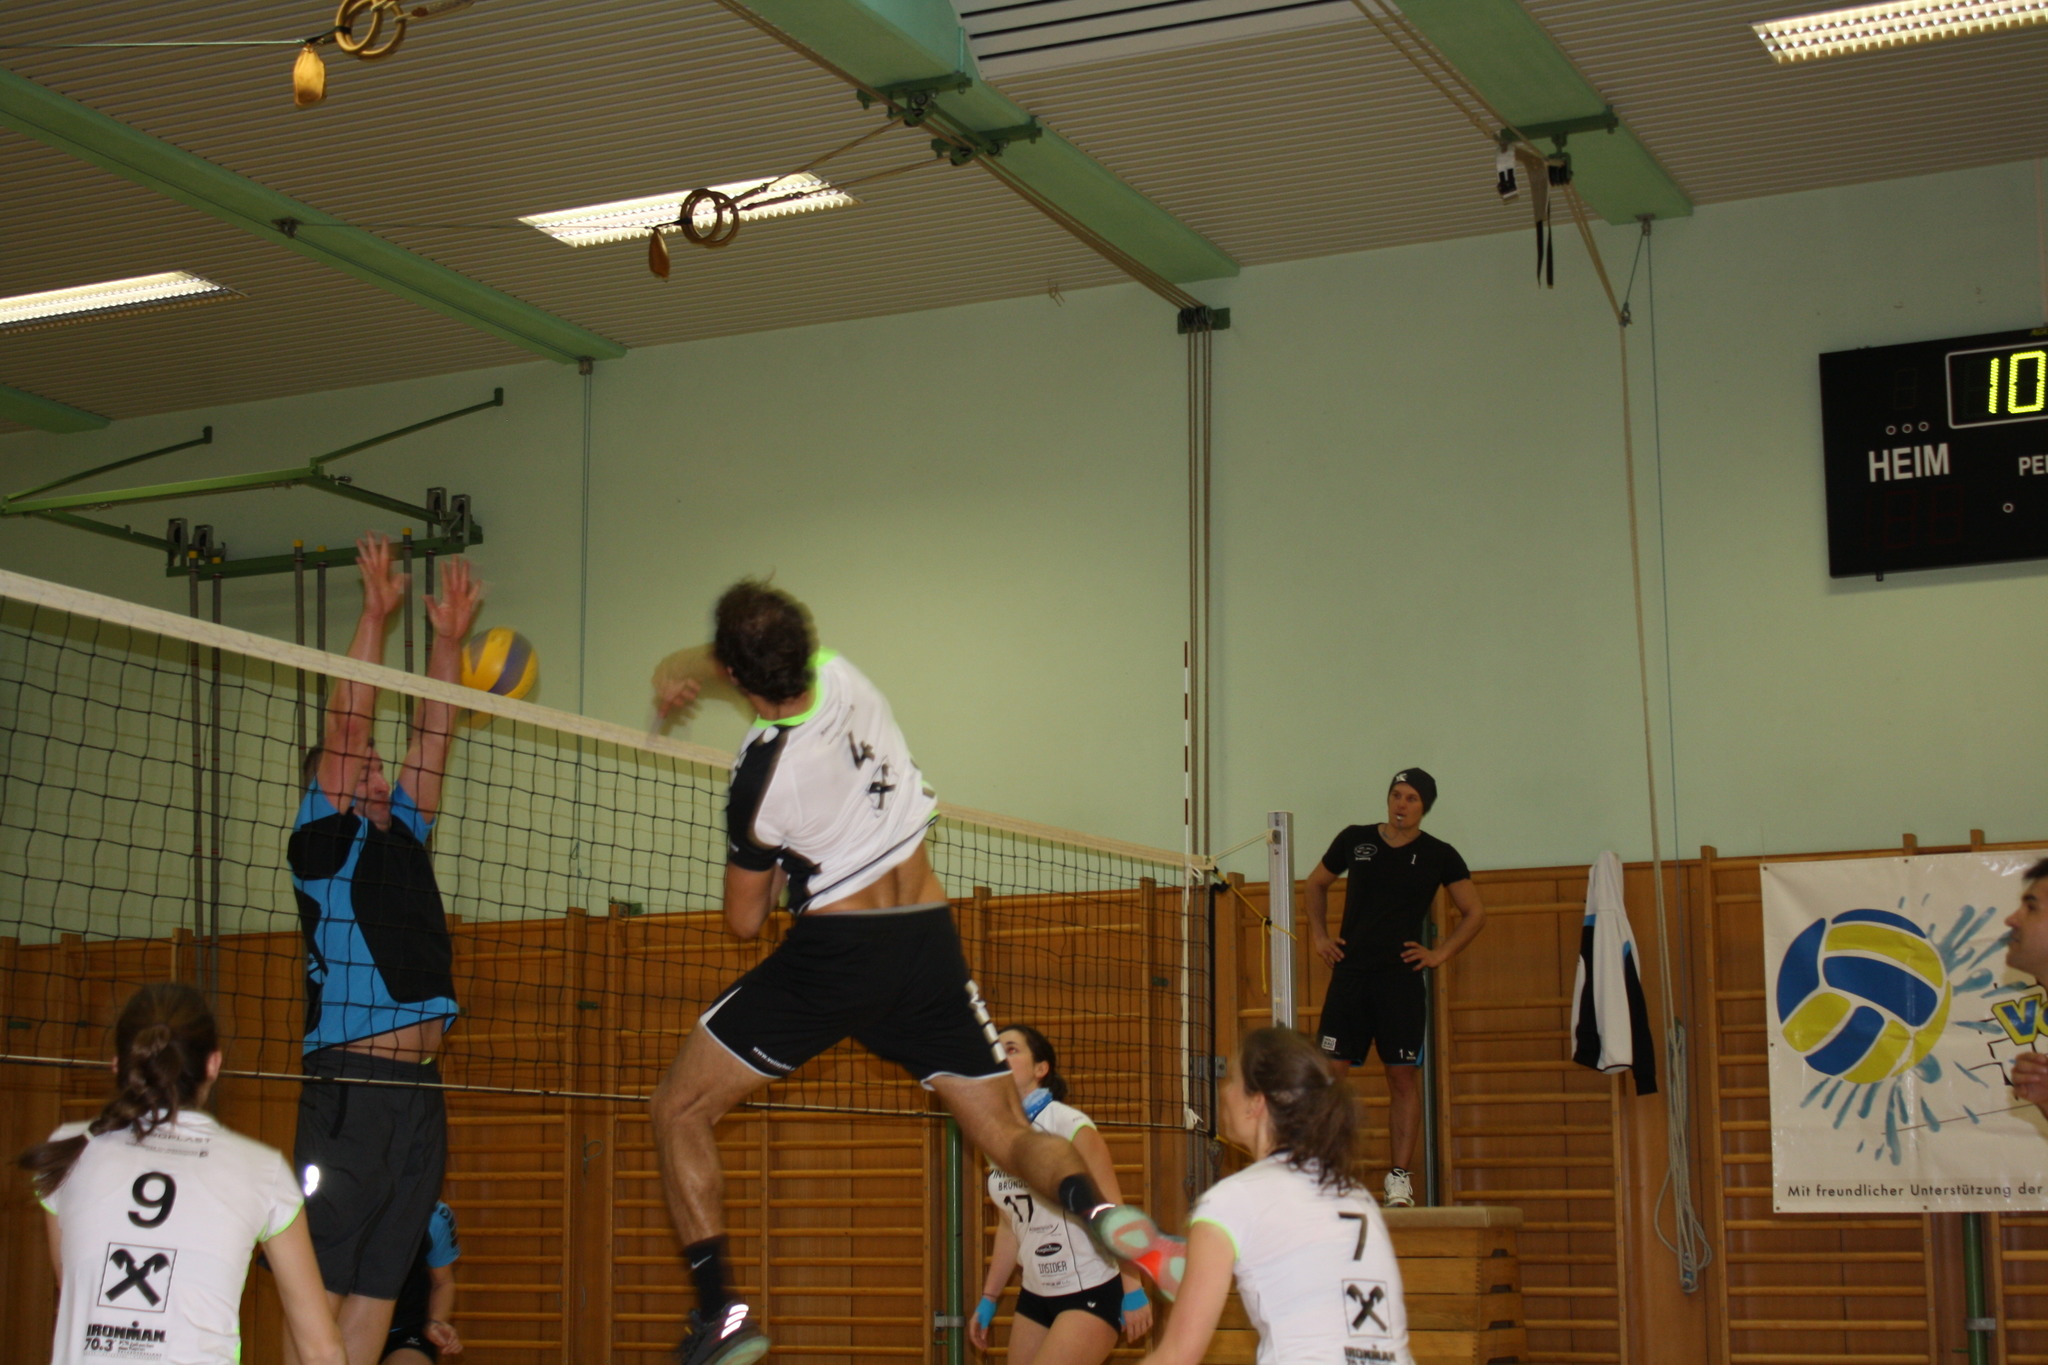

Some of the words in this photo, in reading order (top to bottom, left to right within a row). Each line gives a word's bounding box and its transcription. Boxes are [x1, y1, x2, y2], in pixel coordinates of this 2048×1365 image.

[1988, 350, 2047, 414] 10
[1868, 443, 1951, 482] HEIM
[2018, 455, 2048, 476] PE
[128, 1171, 177, 1229] 9
[1787, 1185, 1810, 1197] Mit
[1816, 1184, 1904, 1197] freundlicher
[1910, 1184, 2011, 1198] Unterstützung
[2018, 1183, 2043, 1195] der
[1004, 1194, 1034, 1223] 17
[1338, 1211, 1368, 1261] 7
[84, 1338, 114, 1352] 70.3
[87, 1321, 166, 1342] IRONMAN
